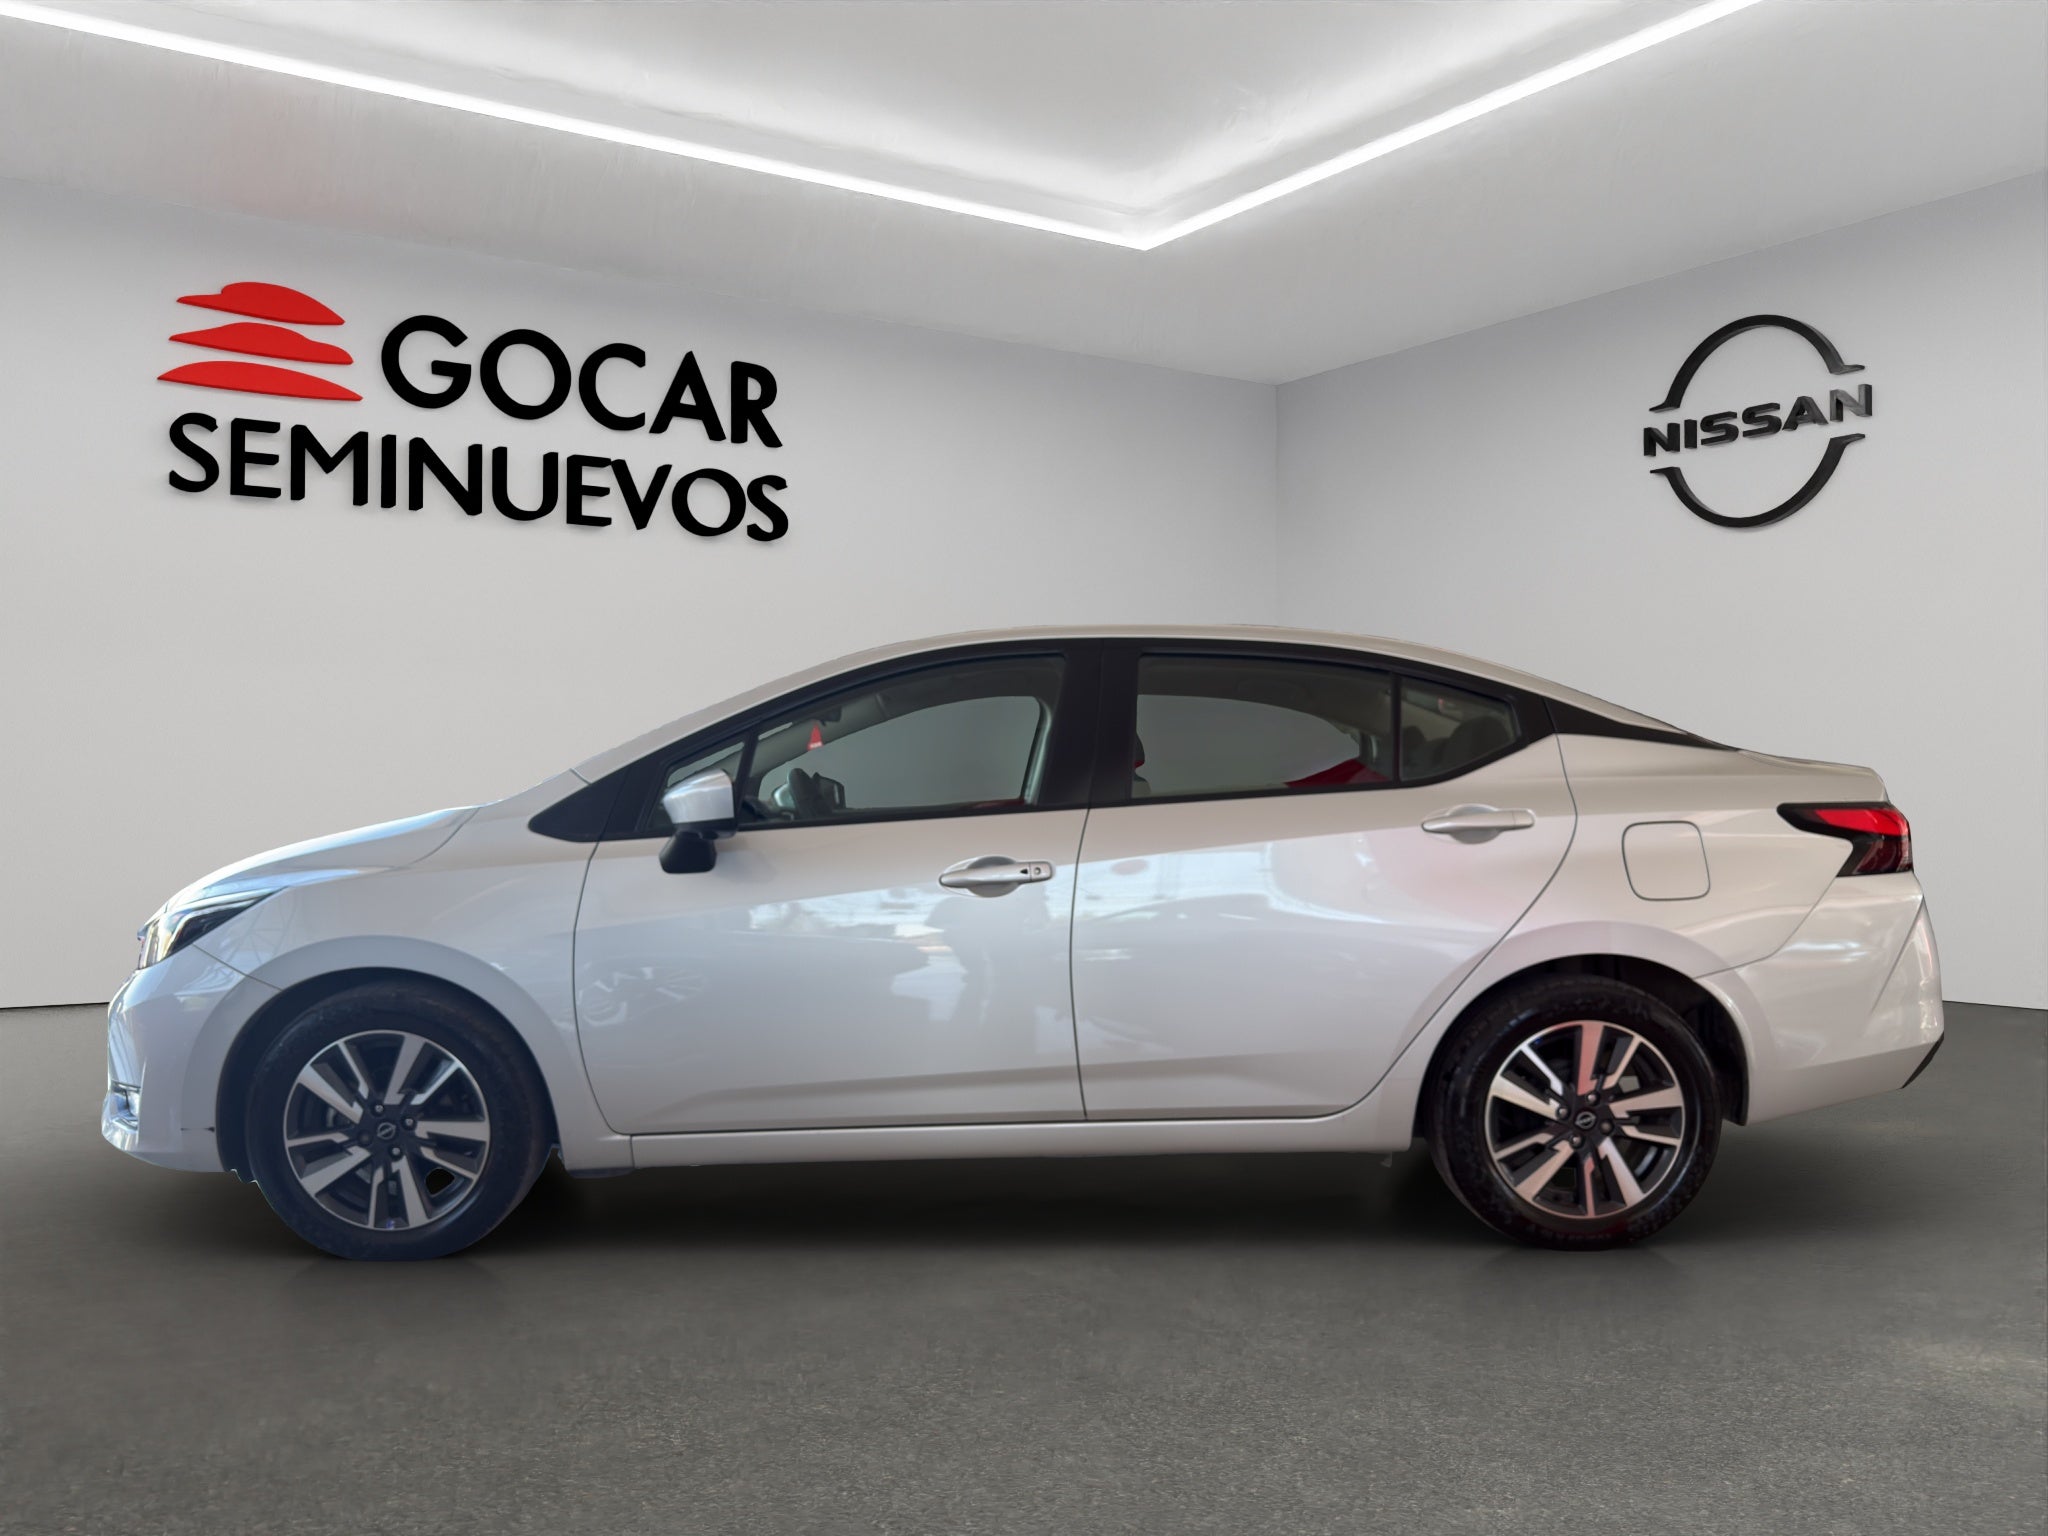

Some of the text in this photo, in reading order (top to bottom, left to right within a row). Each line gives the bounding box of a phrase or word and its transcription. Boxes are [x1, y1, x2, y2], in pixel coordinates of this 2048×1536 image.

[381, 315, 783, 448] GOCAR
[1644, 384, 1873, 456] NISSAN
[169, 413, 789, 542] SEMINUEVOS
